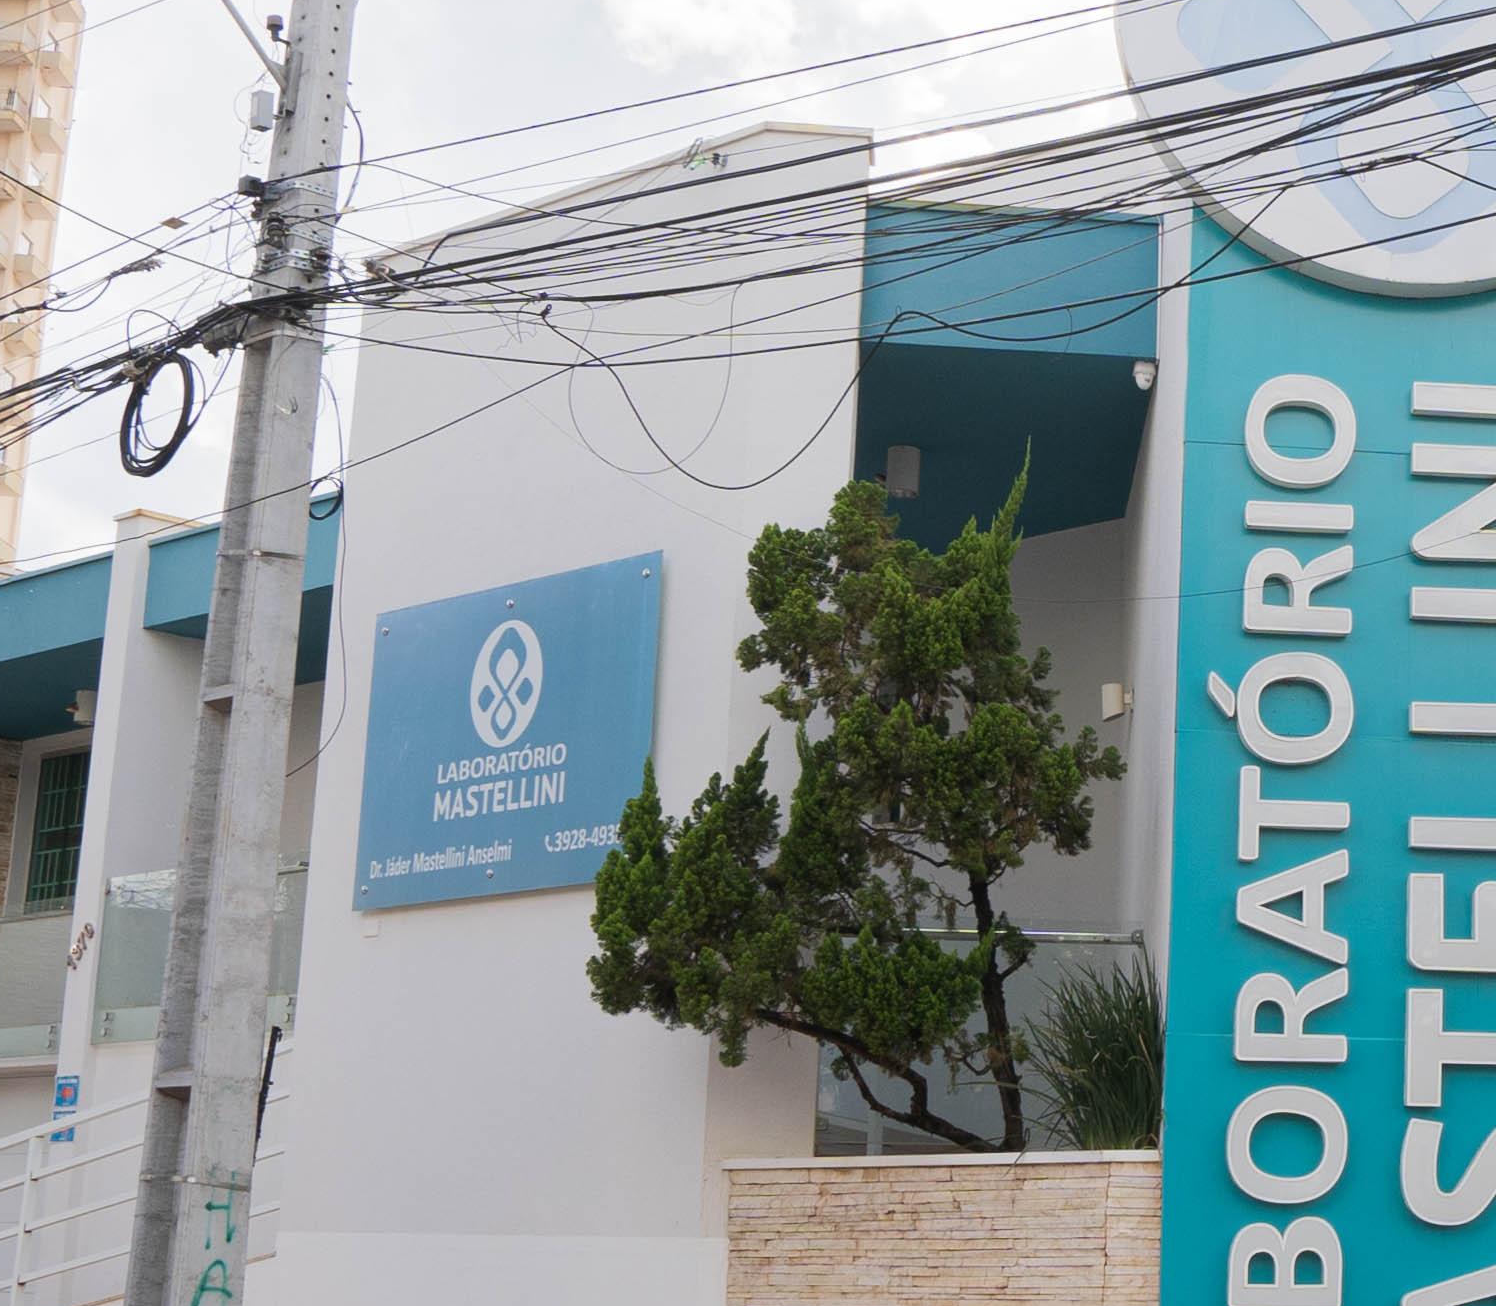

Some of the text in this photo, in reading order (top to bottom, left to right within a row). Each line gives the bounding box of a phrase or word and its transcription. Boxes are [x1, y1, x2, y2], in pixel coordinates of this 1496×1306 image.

[436, 742, 567, 785] LABORATÓRIO
[432, 770, 566, 823] MASTELLINI
[369, 860, 384, 879] Dr.
[412, 845, 465, 873] Mastellini
[466, 838, 512, 866] Anselmi
